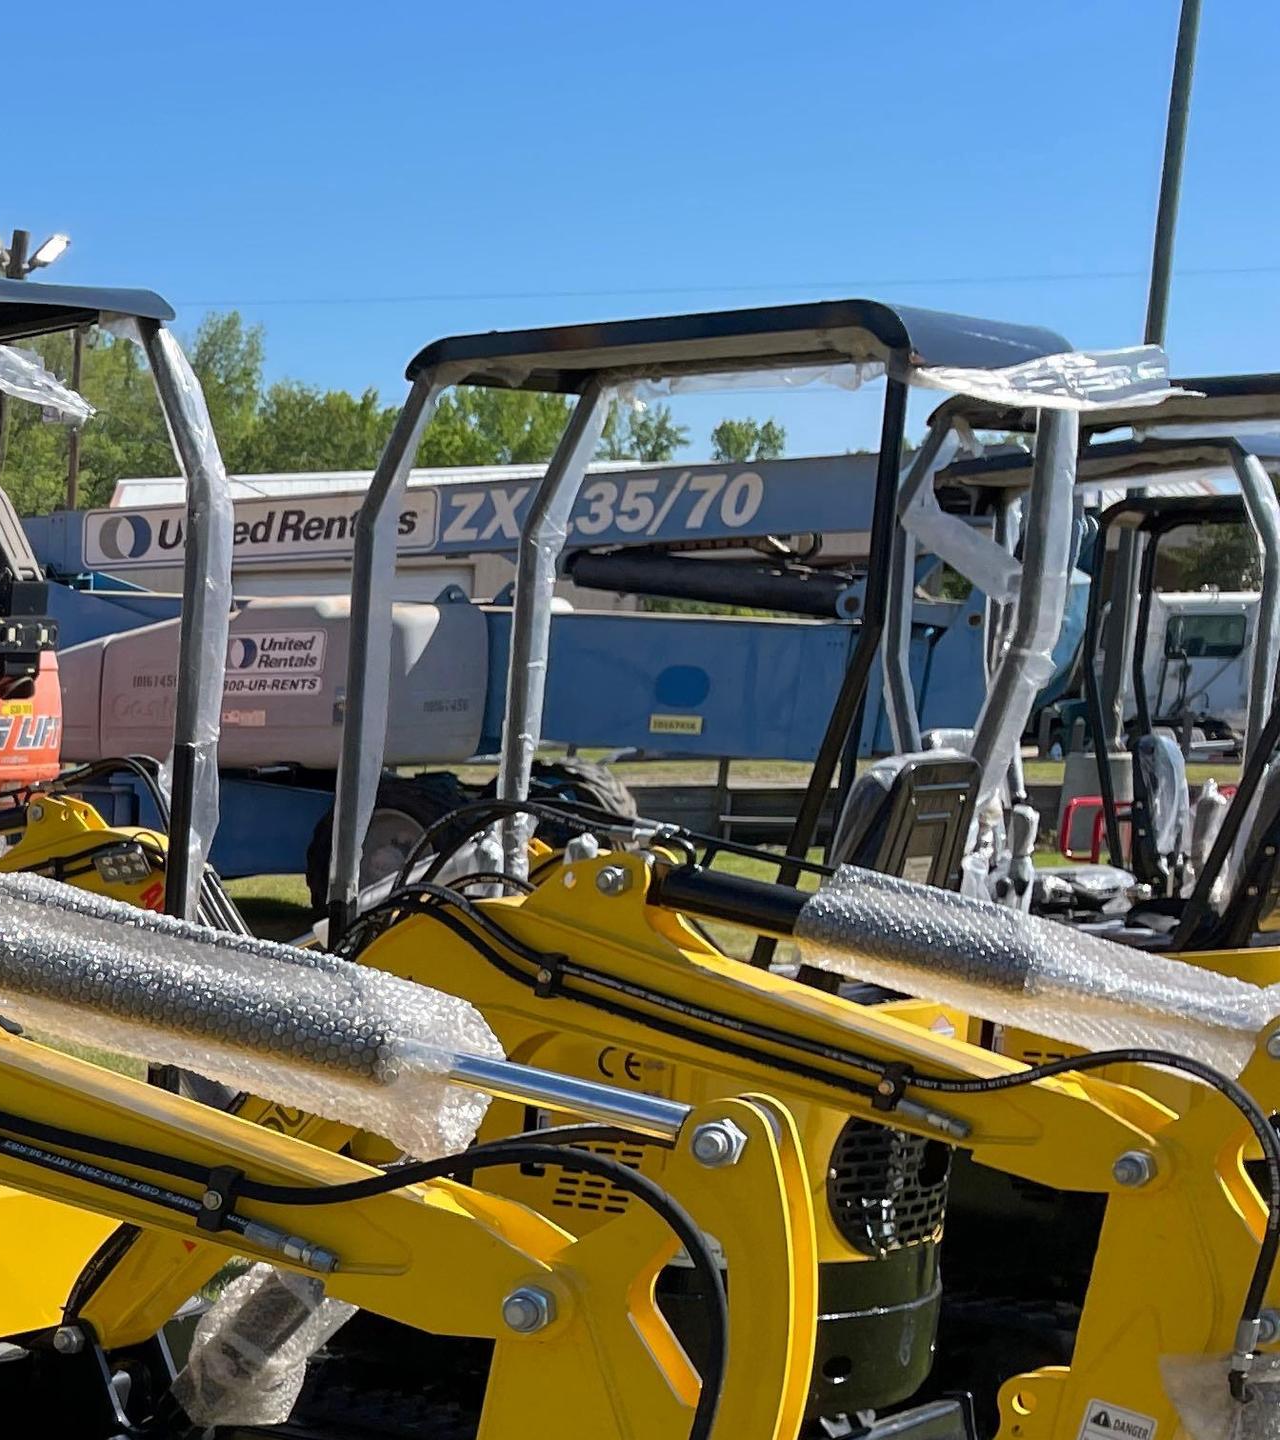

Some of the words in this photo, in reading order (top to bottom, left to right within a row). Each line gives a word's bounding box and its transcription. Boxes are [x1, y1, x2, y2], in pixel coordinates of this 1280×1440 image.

[567, 472, 764, 536] 35/70
[158, 510, 276, 551] Ued
[260, 636, 316, 652] United
[258, 653, 318, 669] Rentals
[1113, 1419, 1148, 1439] DANGER
